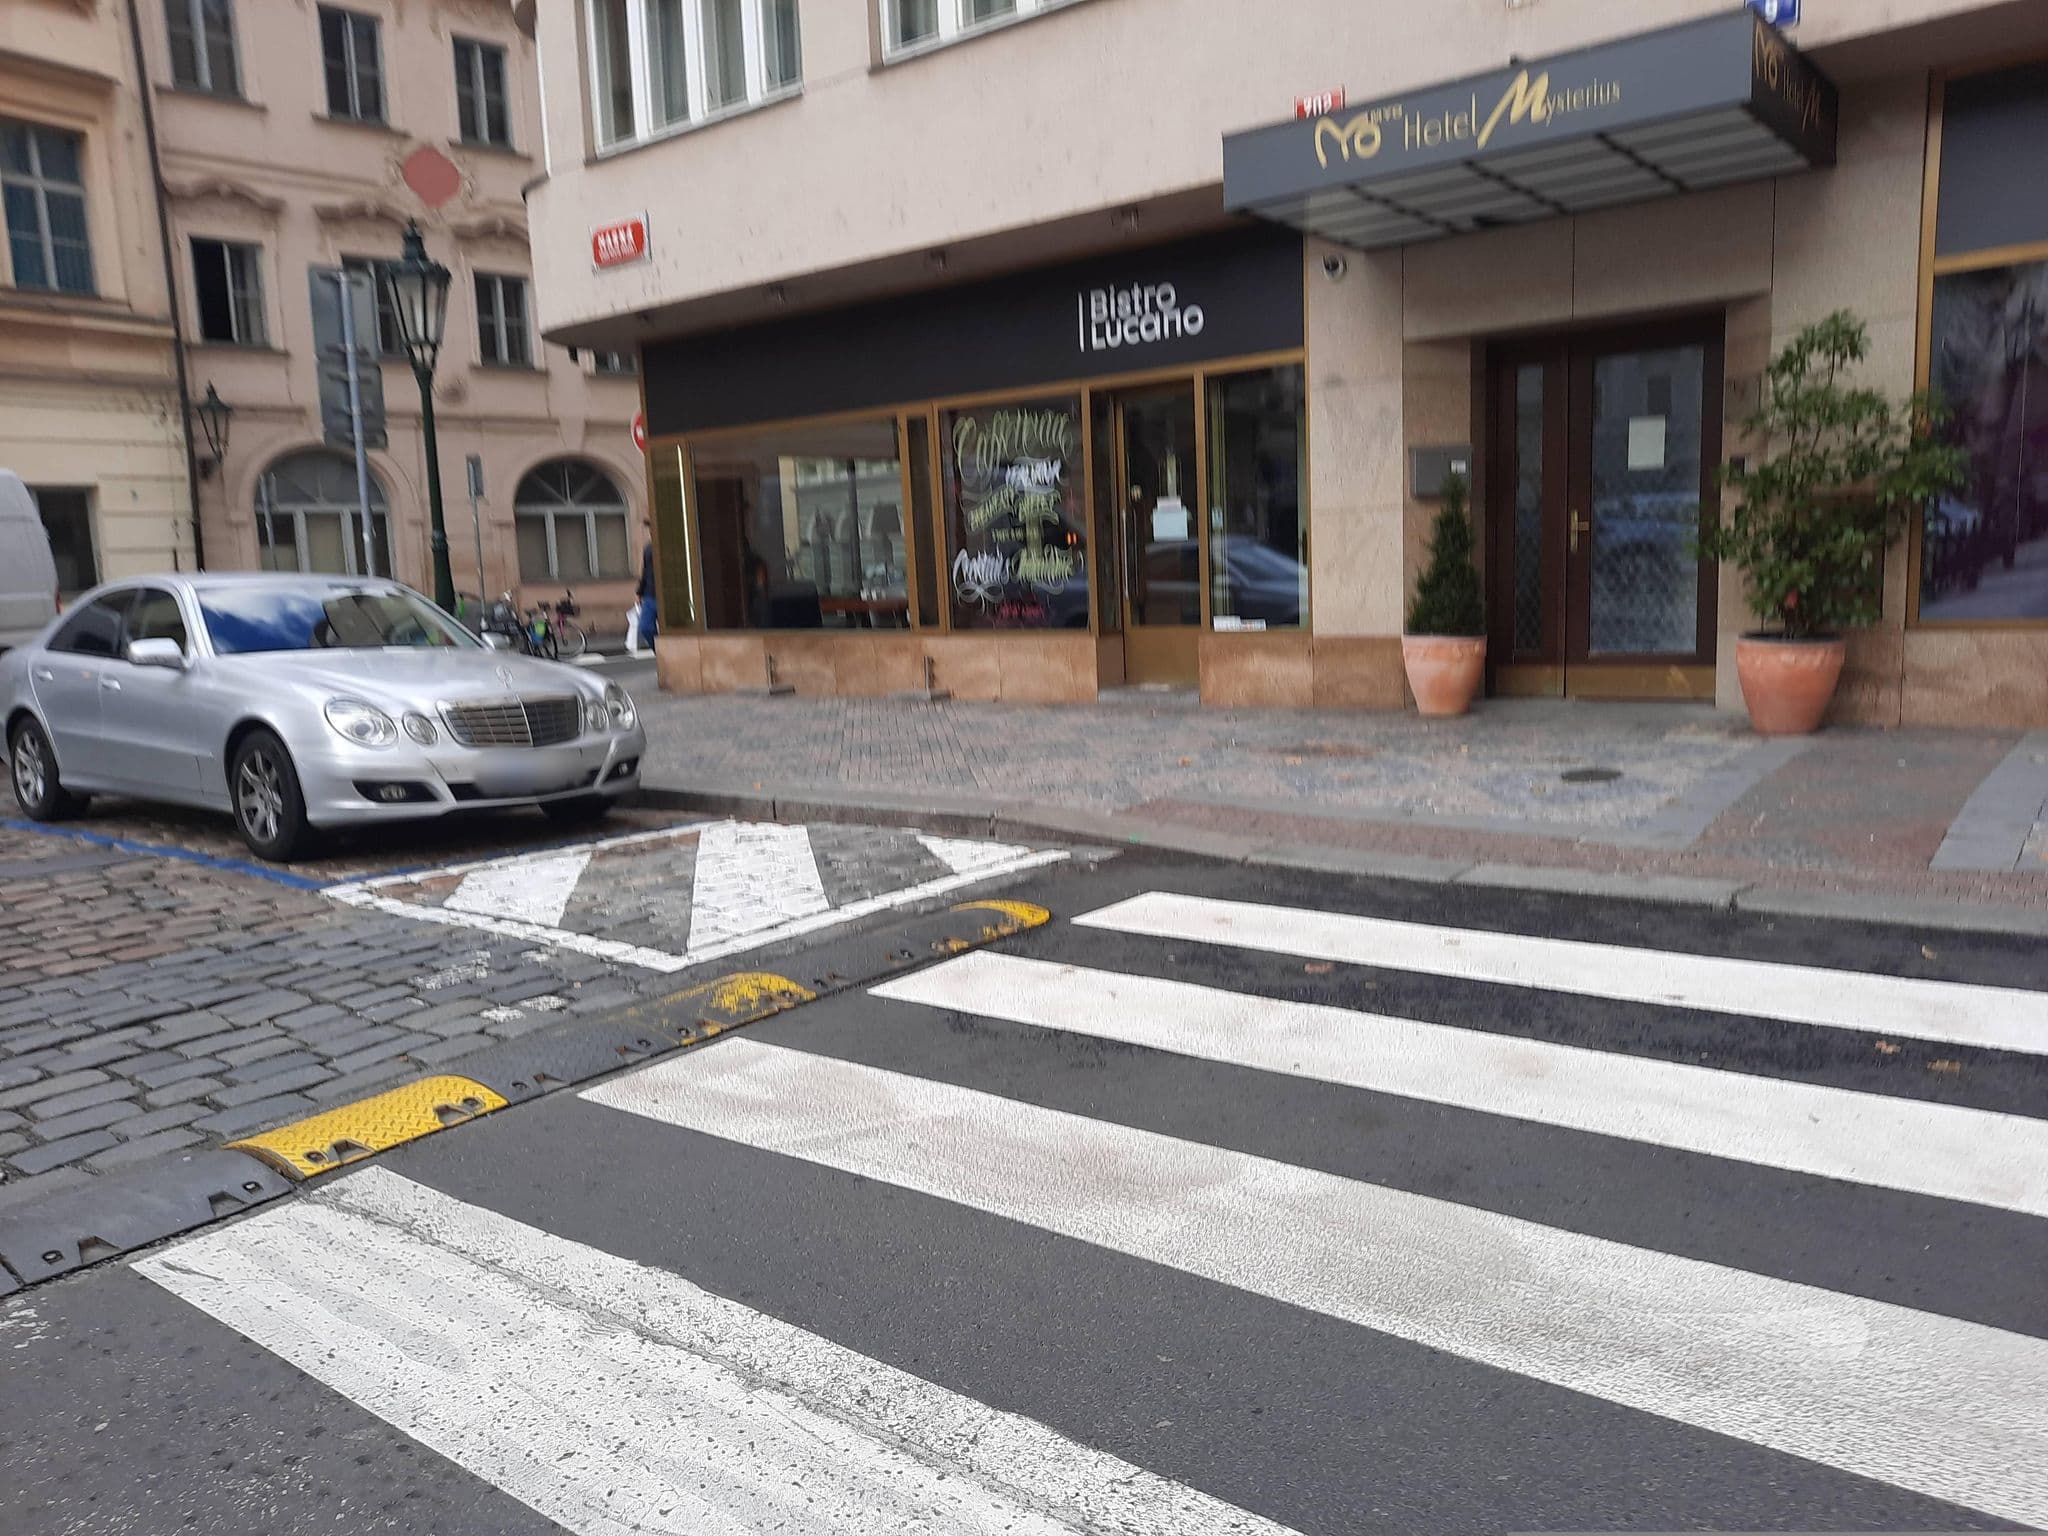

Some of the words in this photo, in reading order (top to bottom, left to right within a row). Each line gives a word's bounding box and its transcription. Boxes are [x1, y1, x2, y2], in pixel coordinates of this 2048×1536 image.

[1404, 92, 1476, 151] Hotel
[1477, 69, 1621, 151] Mysterius
[1090, 281, 1176, 324] Bistro
[1091, 303, 1204, 351] Lucano
